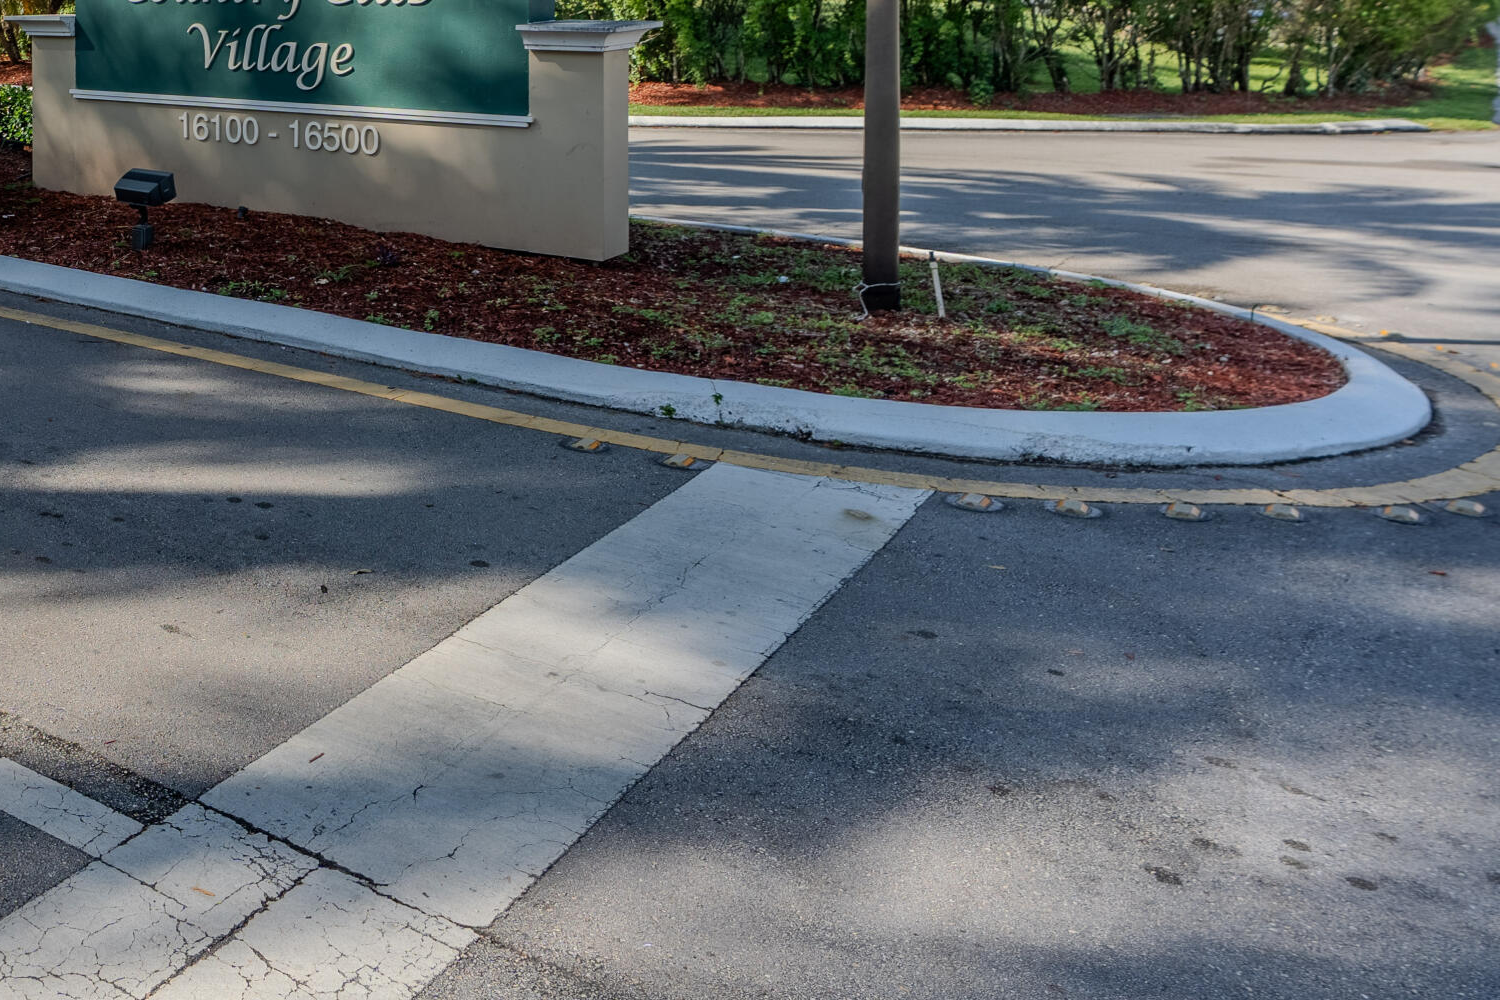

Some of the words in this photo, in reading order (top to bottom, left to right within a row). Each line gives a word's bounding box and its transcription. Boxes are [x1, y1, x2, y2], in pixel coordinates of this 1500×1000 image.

[187, 22, 354, 90] Village
[178, 112, 259, 145] 16100
[289, 120, 380, 155] 16500
